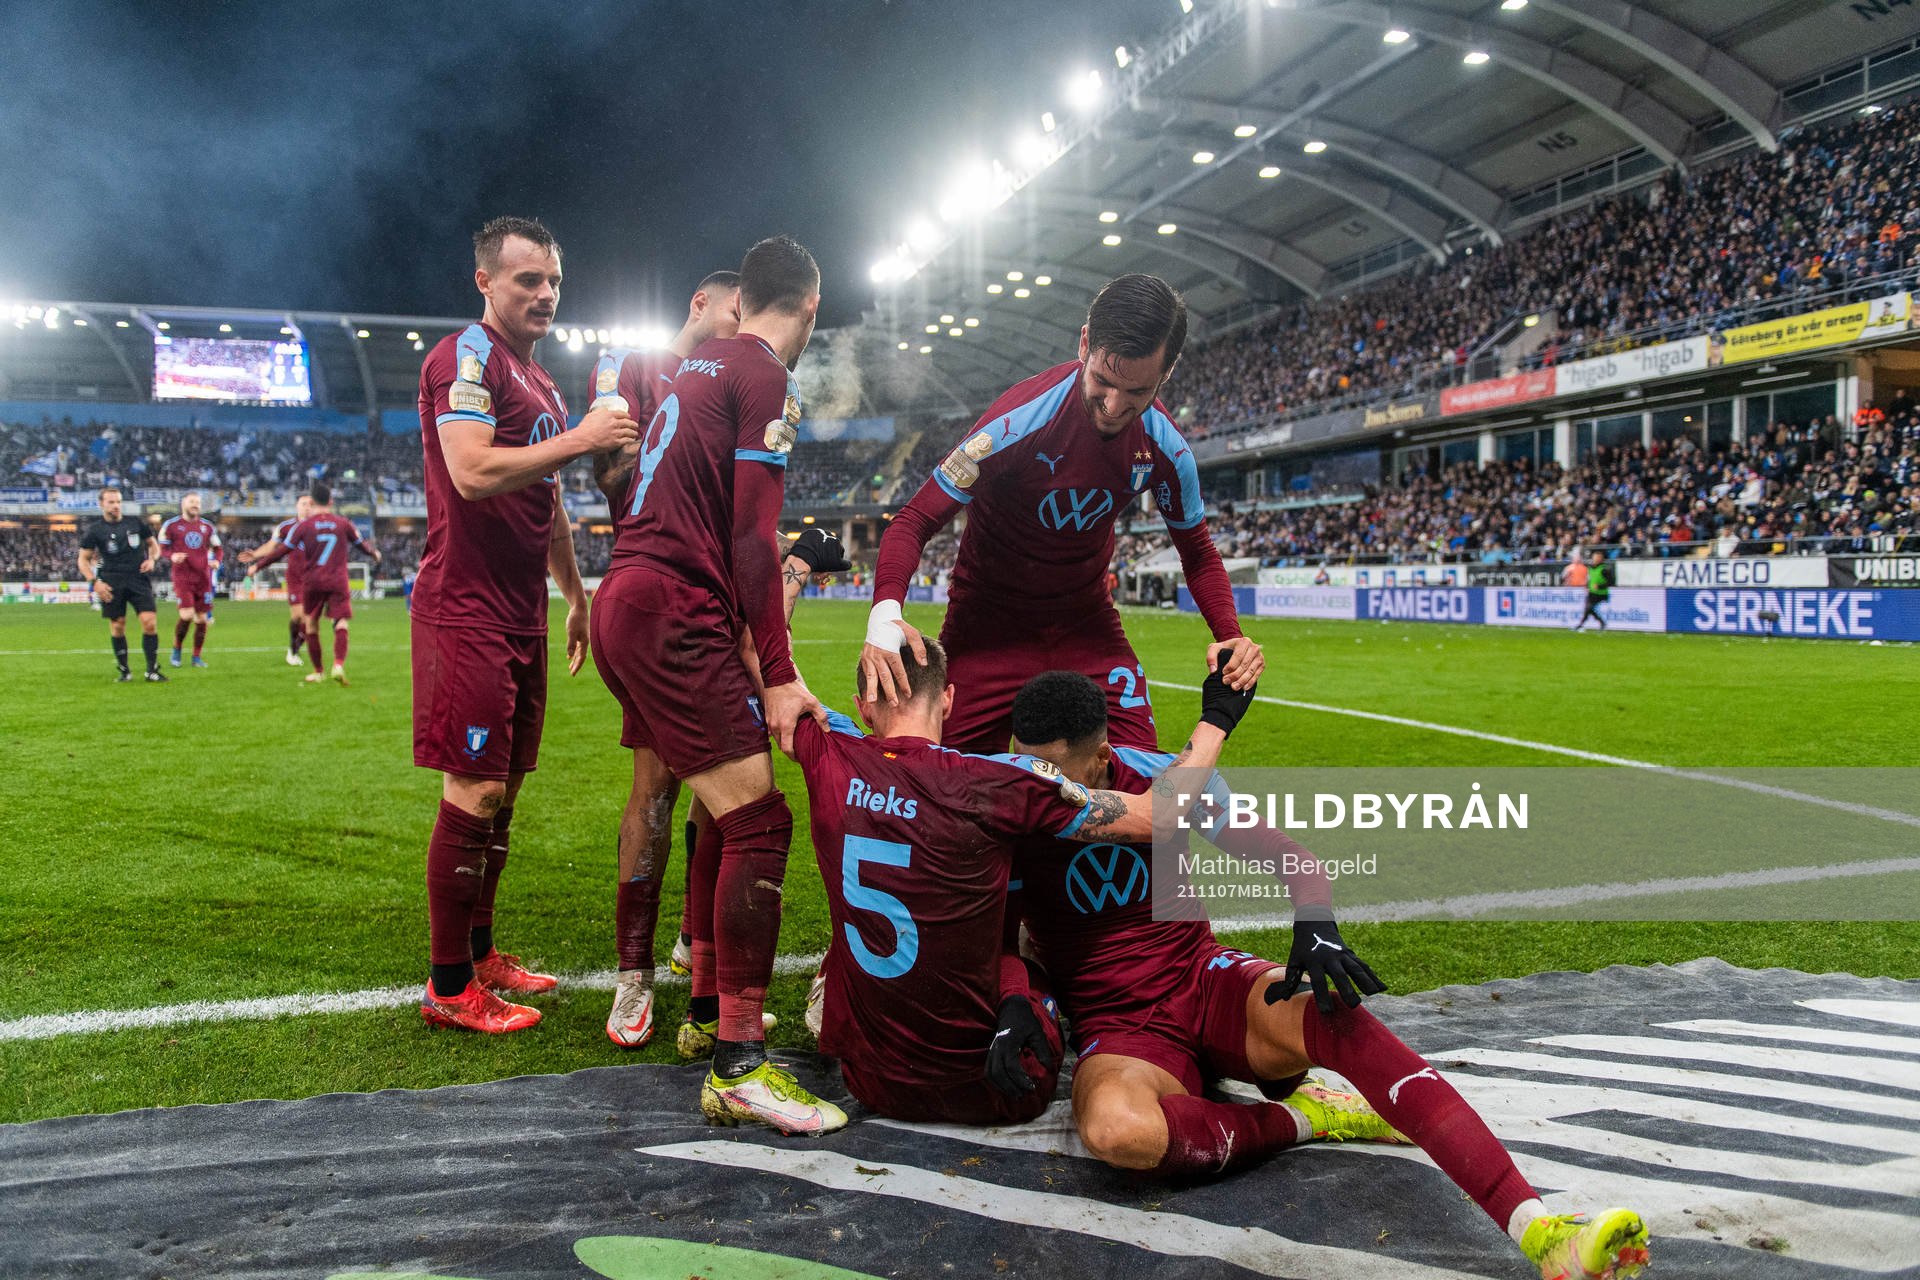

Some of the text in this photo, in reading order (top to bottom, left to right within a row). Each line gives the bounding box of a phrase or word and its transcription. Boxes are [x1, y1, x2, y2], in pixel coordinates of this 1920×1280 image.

[1802, 318, 1822, 332] vår
[1826, 312, 1863, 328] arena
[1570, 358, 1617, 387] higab
[1641, 343, 1694, 375] higab
[315, 533, 338, 566] 7
[1661, 561, 1770, 585] FAMECO
[1368, 590, 1469, 620] FAMECO
[1693, 590, 1874, 636] SERNEKE
[846, 777, 918, 820] Rieks
[842, 834, 919, 979] 5
